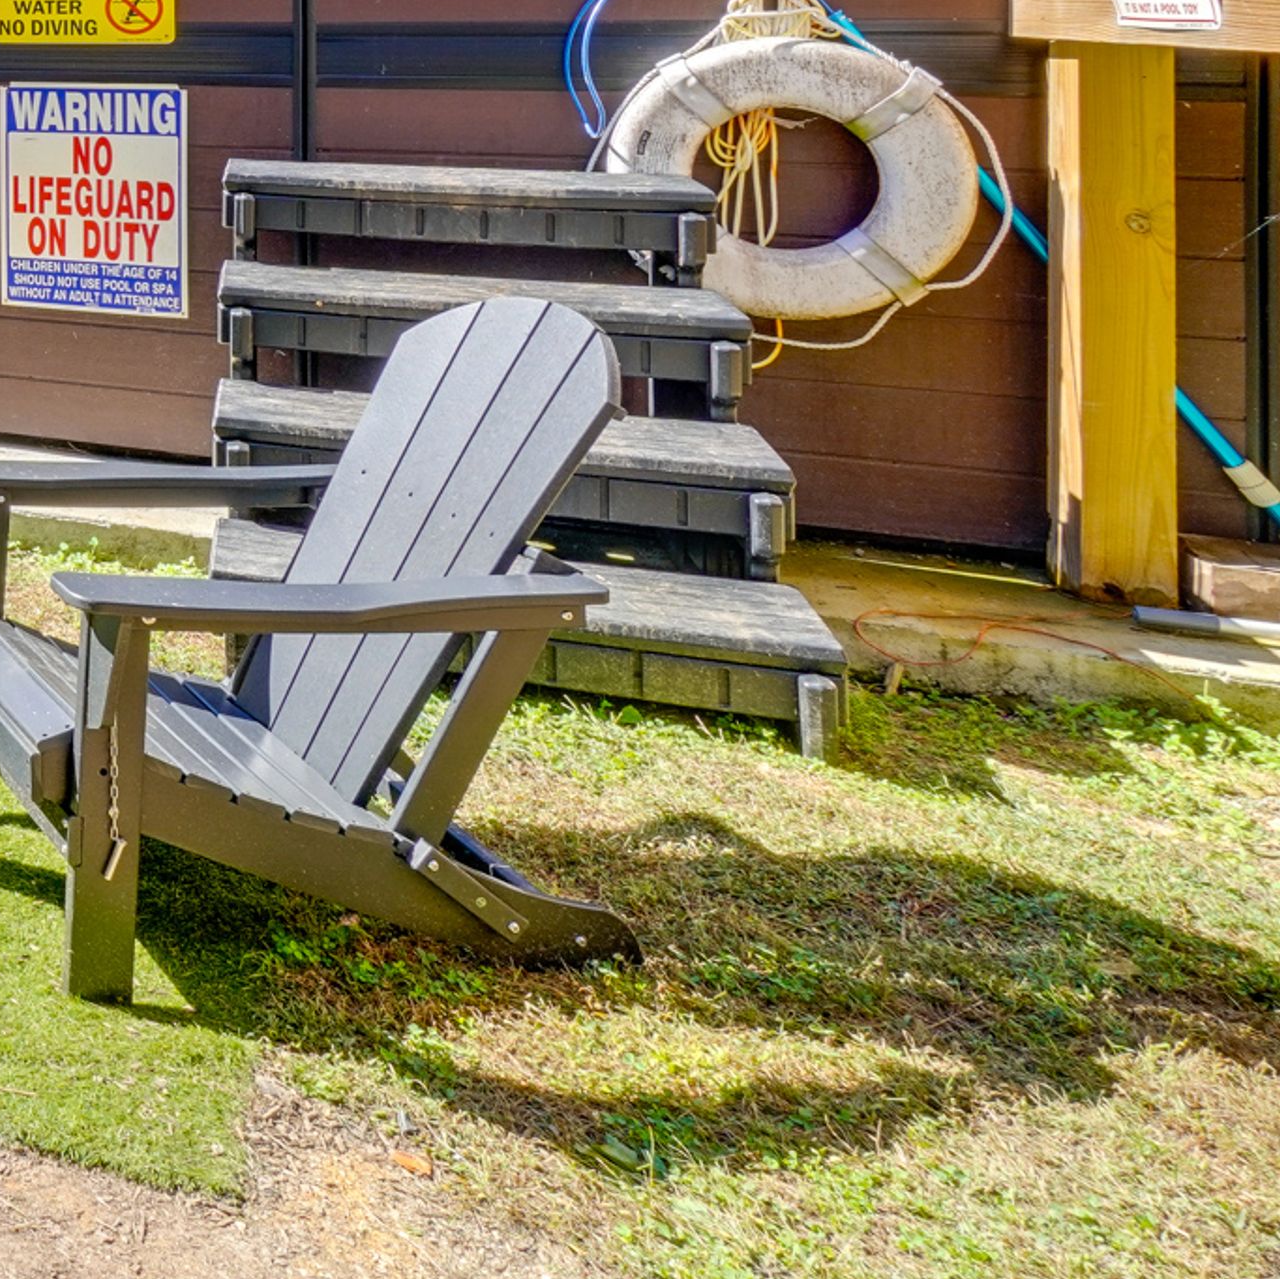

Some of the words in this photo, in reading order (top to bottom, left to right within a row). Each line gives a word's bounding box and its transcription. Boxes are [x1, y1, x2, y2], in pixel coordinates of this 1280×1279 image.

[14, 0, 82, 15] WATER
[0, 20, 25, 36] NO
[31, 19, 98, 36] DIVING
[10, 90, 176, 134] WARNING
[72, 136, 113, 176] NO
[13, 175, 176, 221] LIFEGUARD
[27, 217, 66, 256] ON
[83, 220, 160, 262] DUTY
[11, 259, 61, 272] CHILDREN
[63, 262, 98, 275] UNDER
[101, 265, 120, 277] THE
[123, 267, 145, 279] AGE
[147, 269, 162, 280] OF
[165, 269, 177, 281] 14
[14, 272, 55, 287] SHOULD
[57, 275, 78, 288] NOT
[80, 278, 100, 290] USE
[103, 279, 132, 292] POOL
[134, 281, 150, 294] OR
[152, 282, 174, 295] SPA
[9, 285, 51, 300] WITHOUT
[53, 289, 67, 300] AN
[69, 290, 100, 303] ADULT
[102, 292, 113, 304] IN
[114, 293, 180, 309] ATTENDANCE
